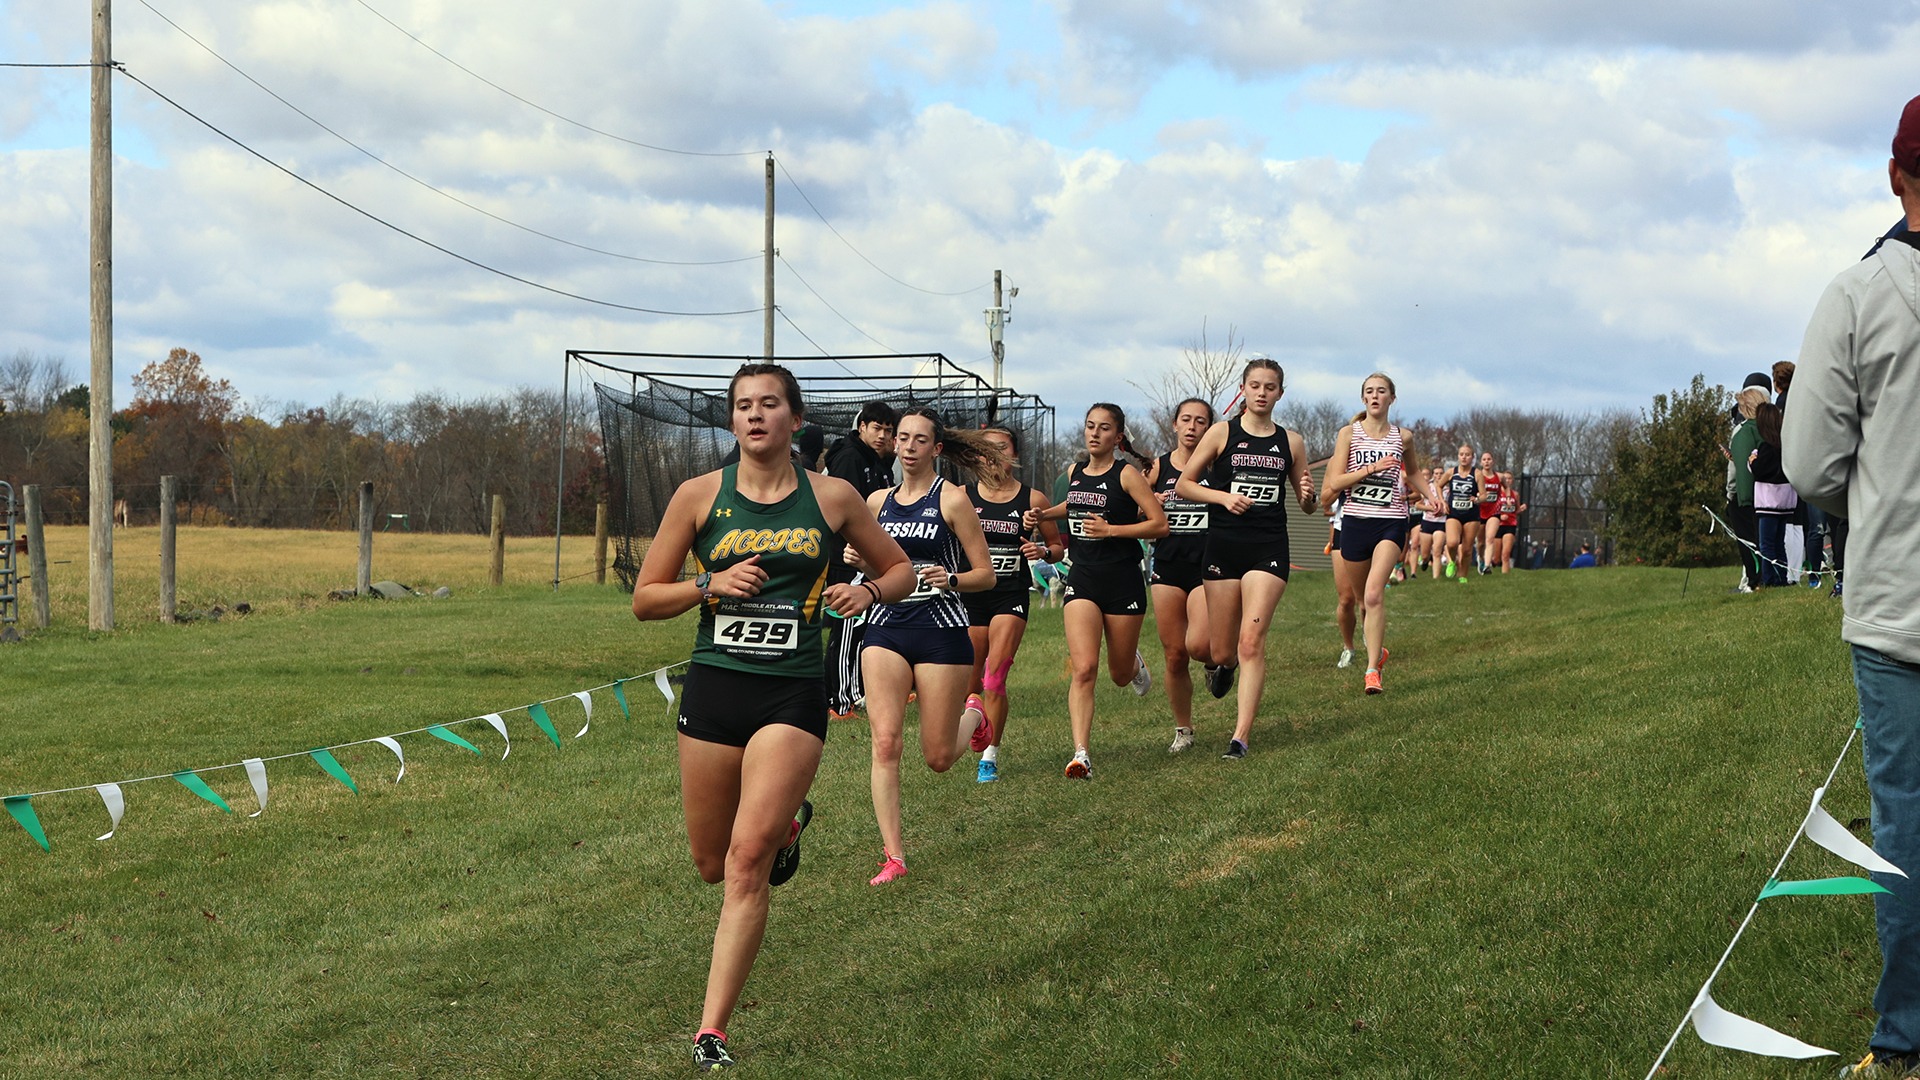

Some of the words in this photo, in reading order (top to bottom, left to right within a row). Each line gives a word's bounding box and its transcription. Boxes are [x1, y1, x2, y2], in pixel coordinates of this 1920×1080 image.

[1231, 453, 1285, 471] STEVENS
[1067, 491, 1108, 508] STEVENS
[1237, 485, 1277, 500] 535
[1354, 486, 1392, 500] 447
[980, 519, 1020, 535] TEVENS
[1167, 514, 1206, 527] 537
[709, 527, 822, 561] AGGIES
[764, 603, 795, 611] ATLANTIC
[720, 620, 794, 645] 439
